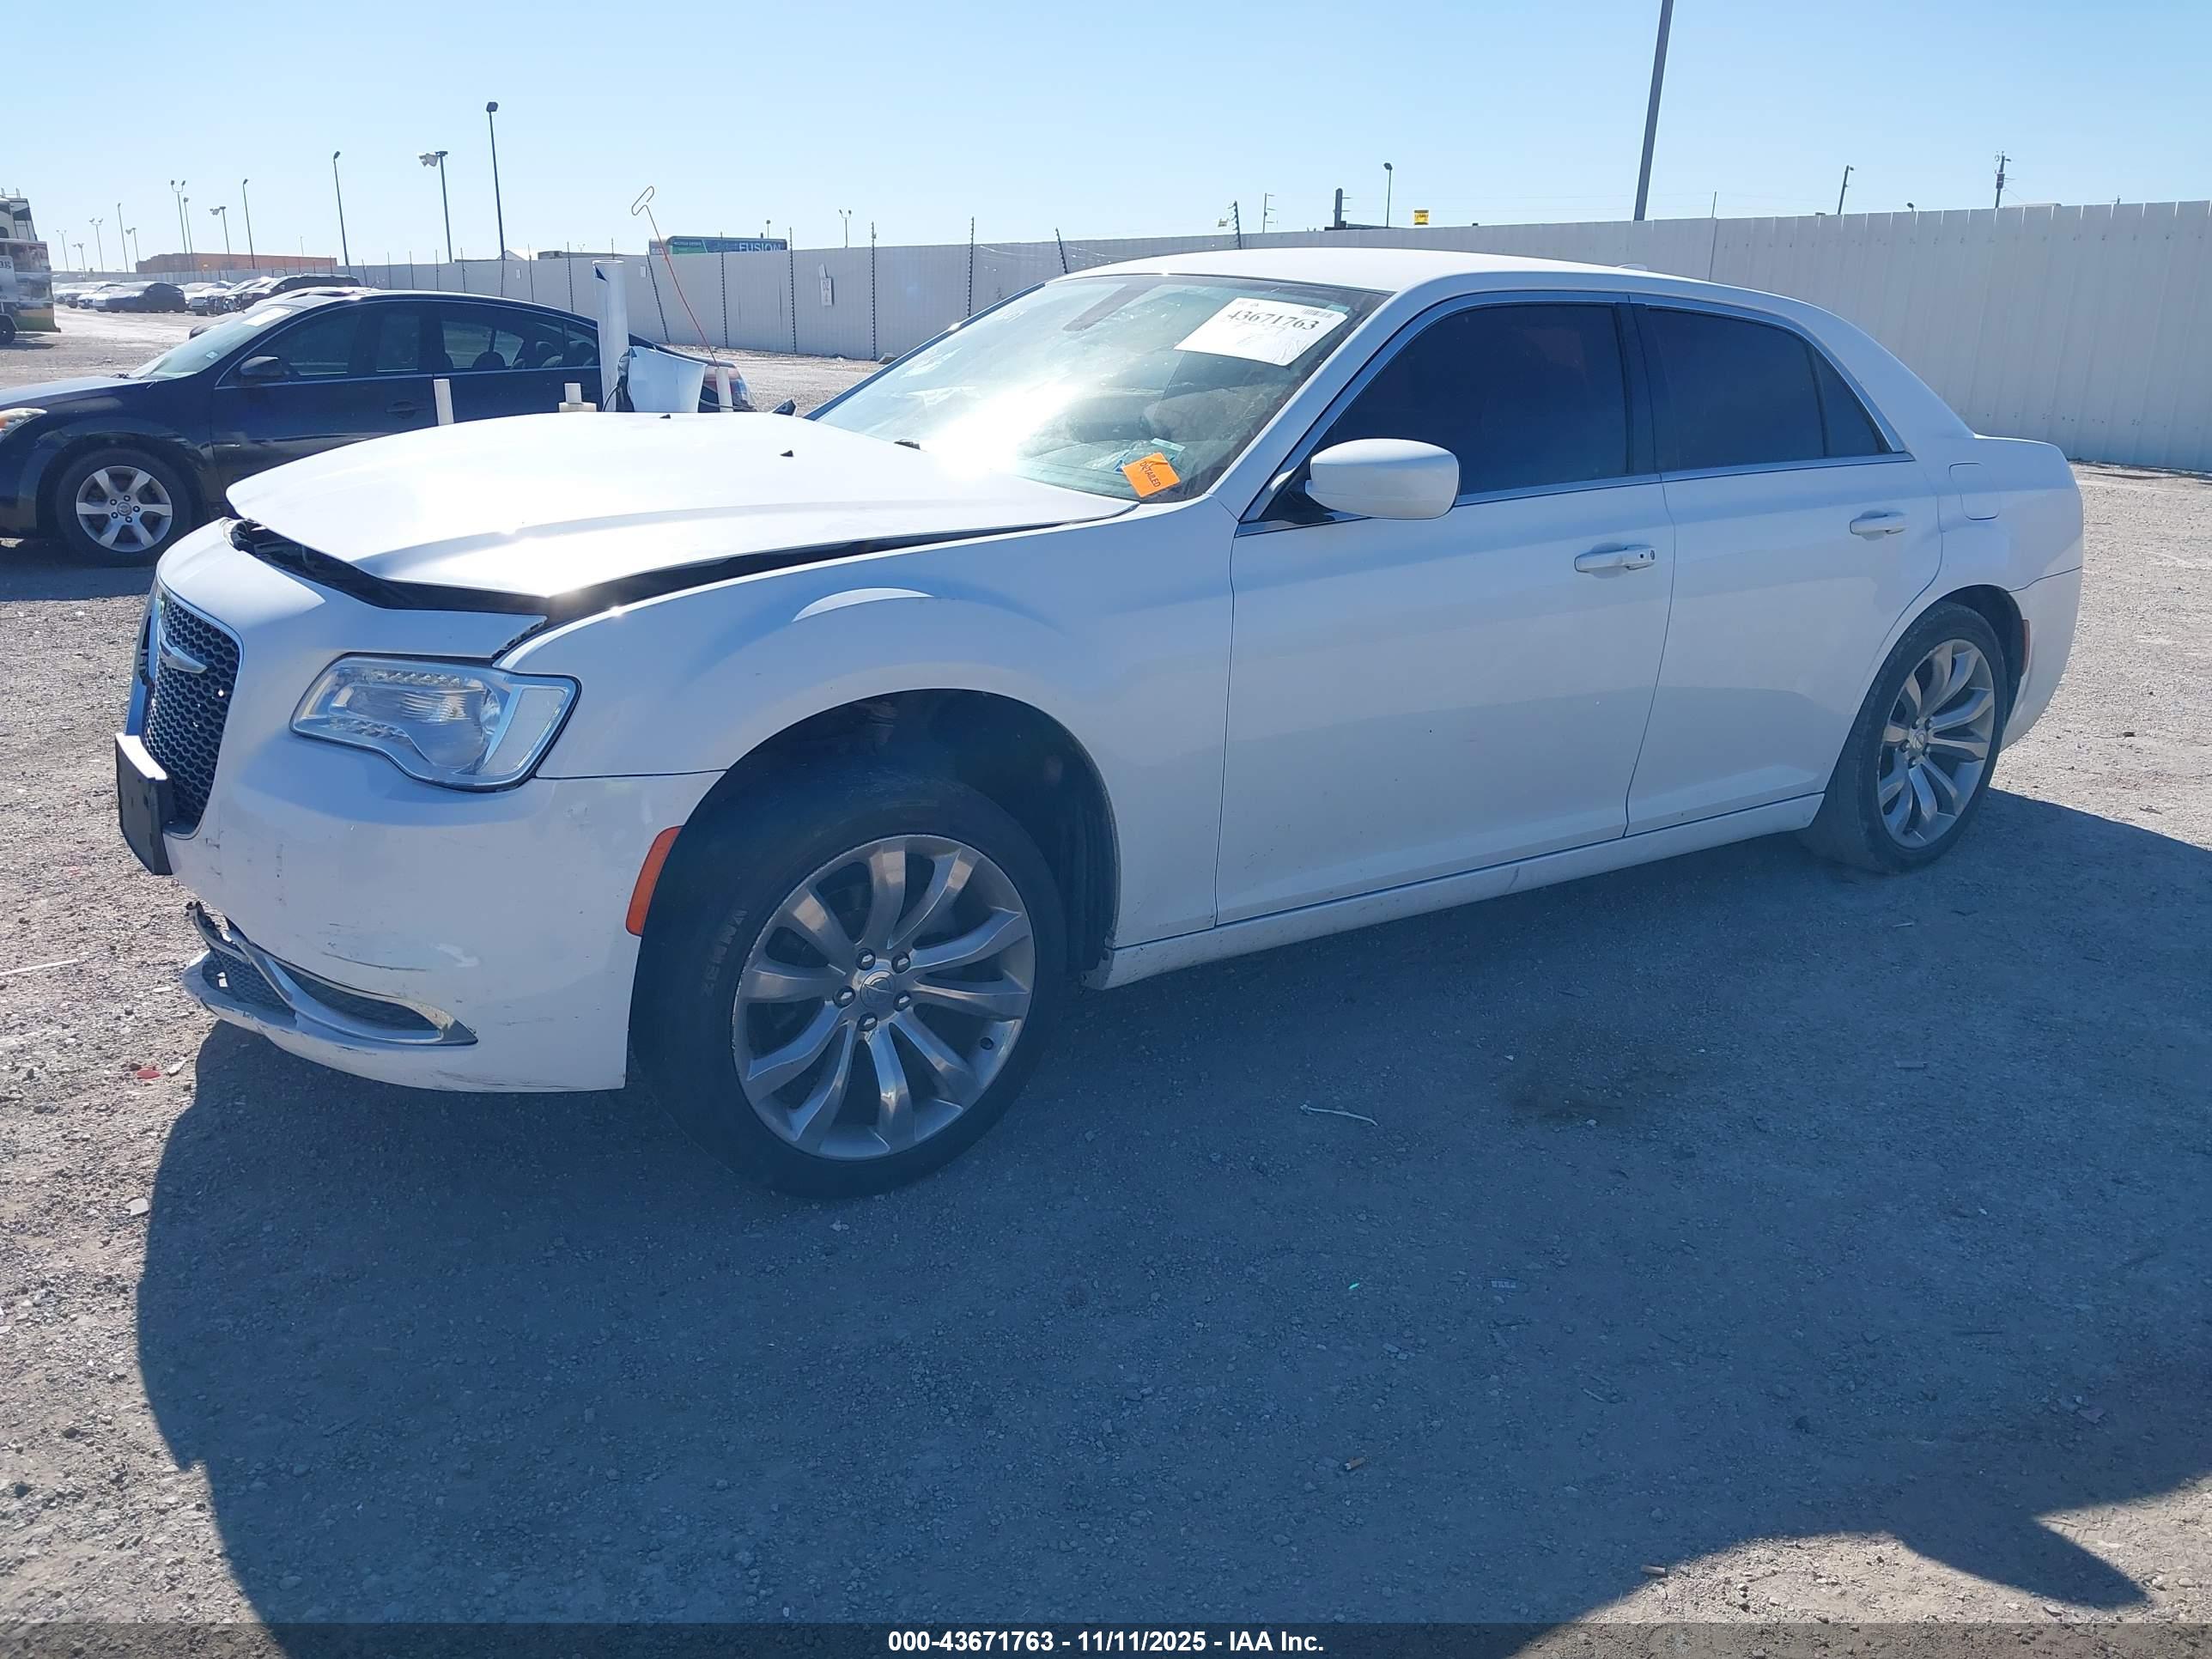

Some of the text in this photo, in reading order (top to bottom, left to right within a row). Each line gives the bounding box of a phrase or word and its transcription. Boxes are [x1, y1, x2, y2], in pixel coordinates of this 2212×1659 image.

[738, 242, 781, 252] FUSION
[1227, 309, 1320, 331] 43671763
[1139, 460, 1162, 488] DETAILED
